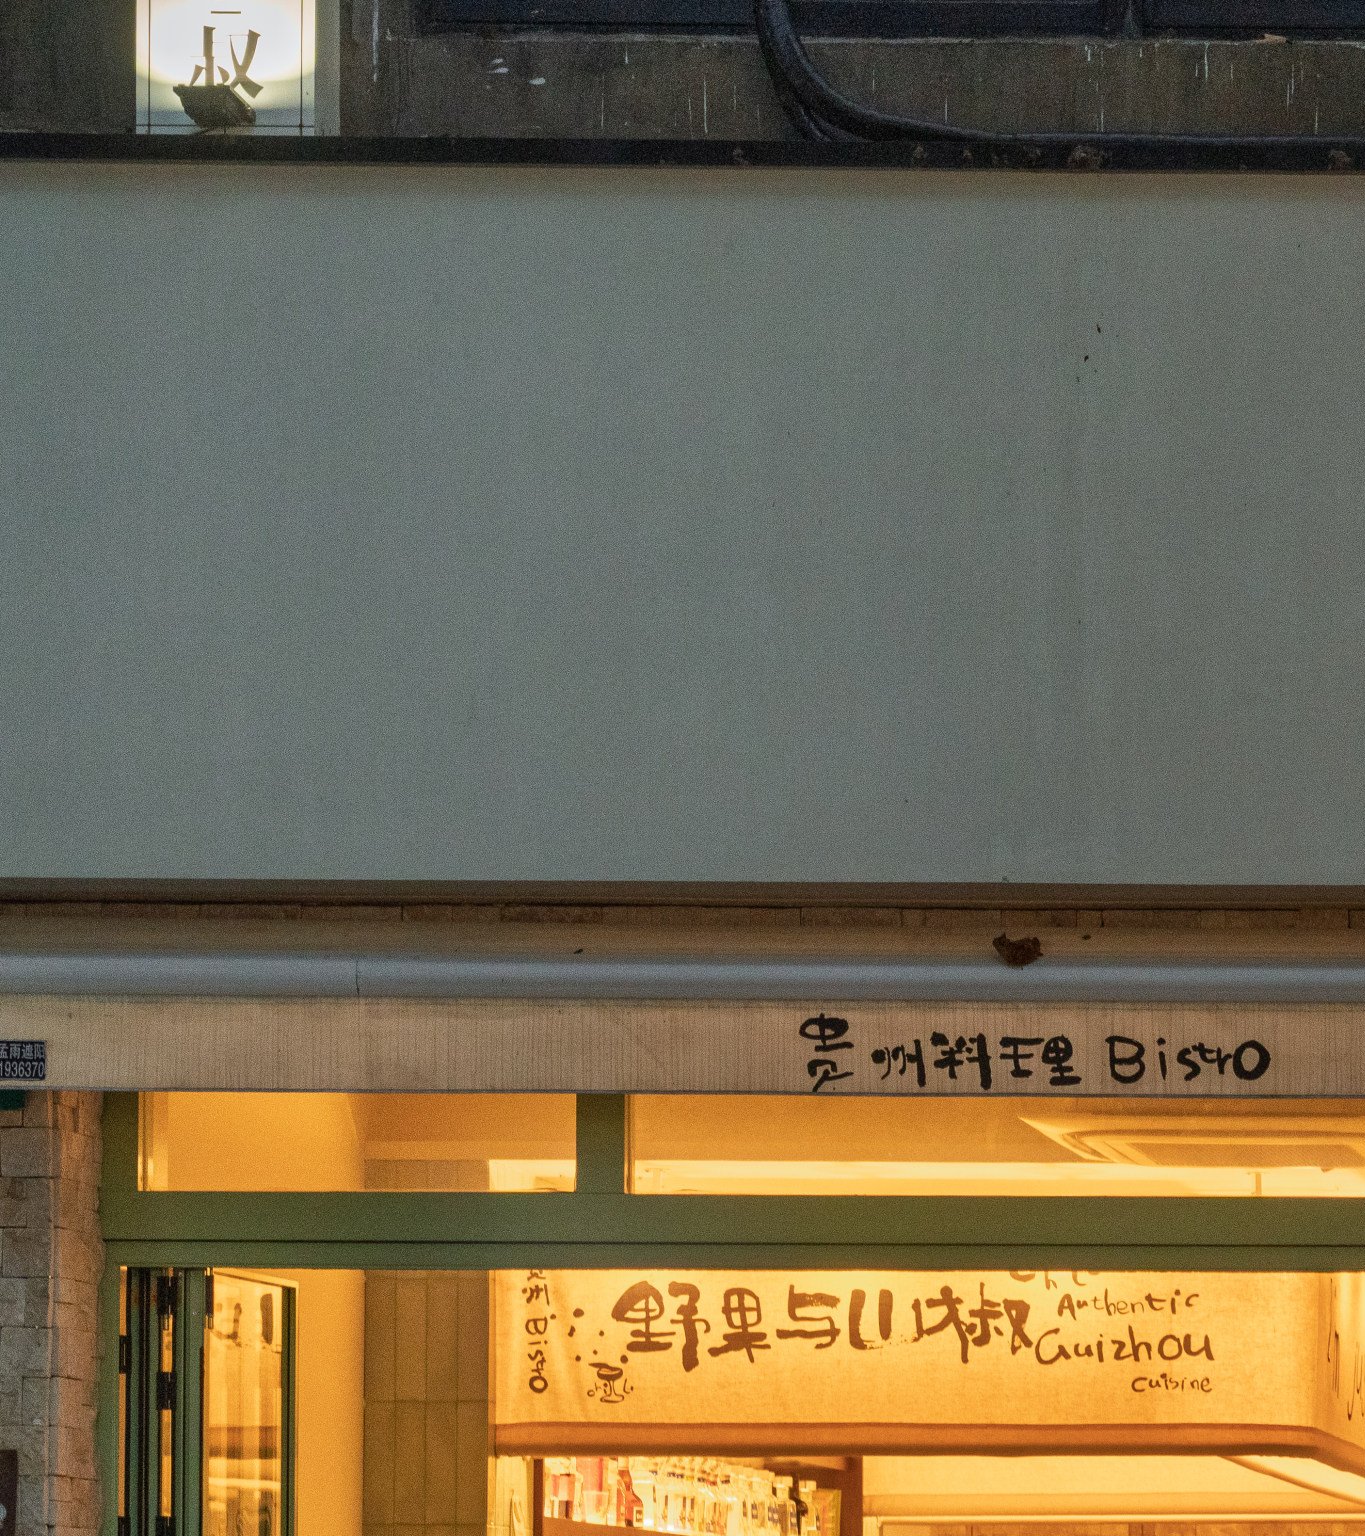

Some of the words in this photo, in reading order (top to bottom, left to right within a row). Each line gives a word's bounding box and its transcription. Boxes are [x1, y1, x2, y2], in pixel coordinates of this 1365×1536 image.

[799, 1012, 1082, 1093] 贵州料理
[1105, 1035, 1271, 1085] Bistro
[1057, 1288, 1200, 1321] Authentic
[1035, 1324, 1215, 1366] Guizhou
[1131, 1372, 1213, 1393] cuisine
